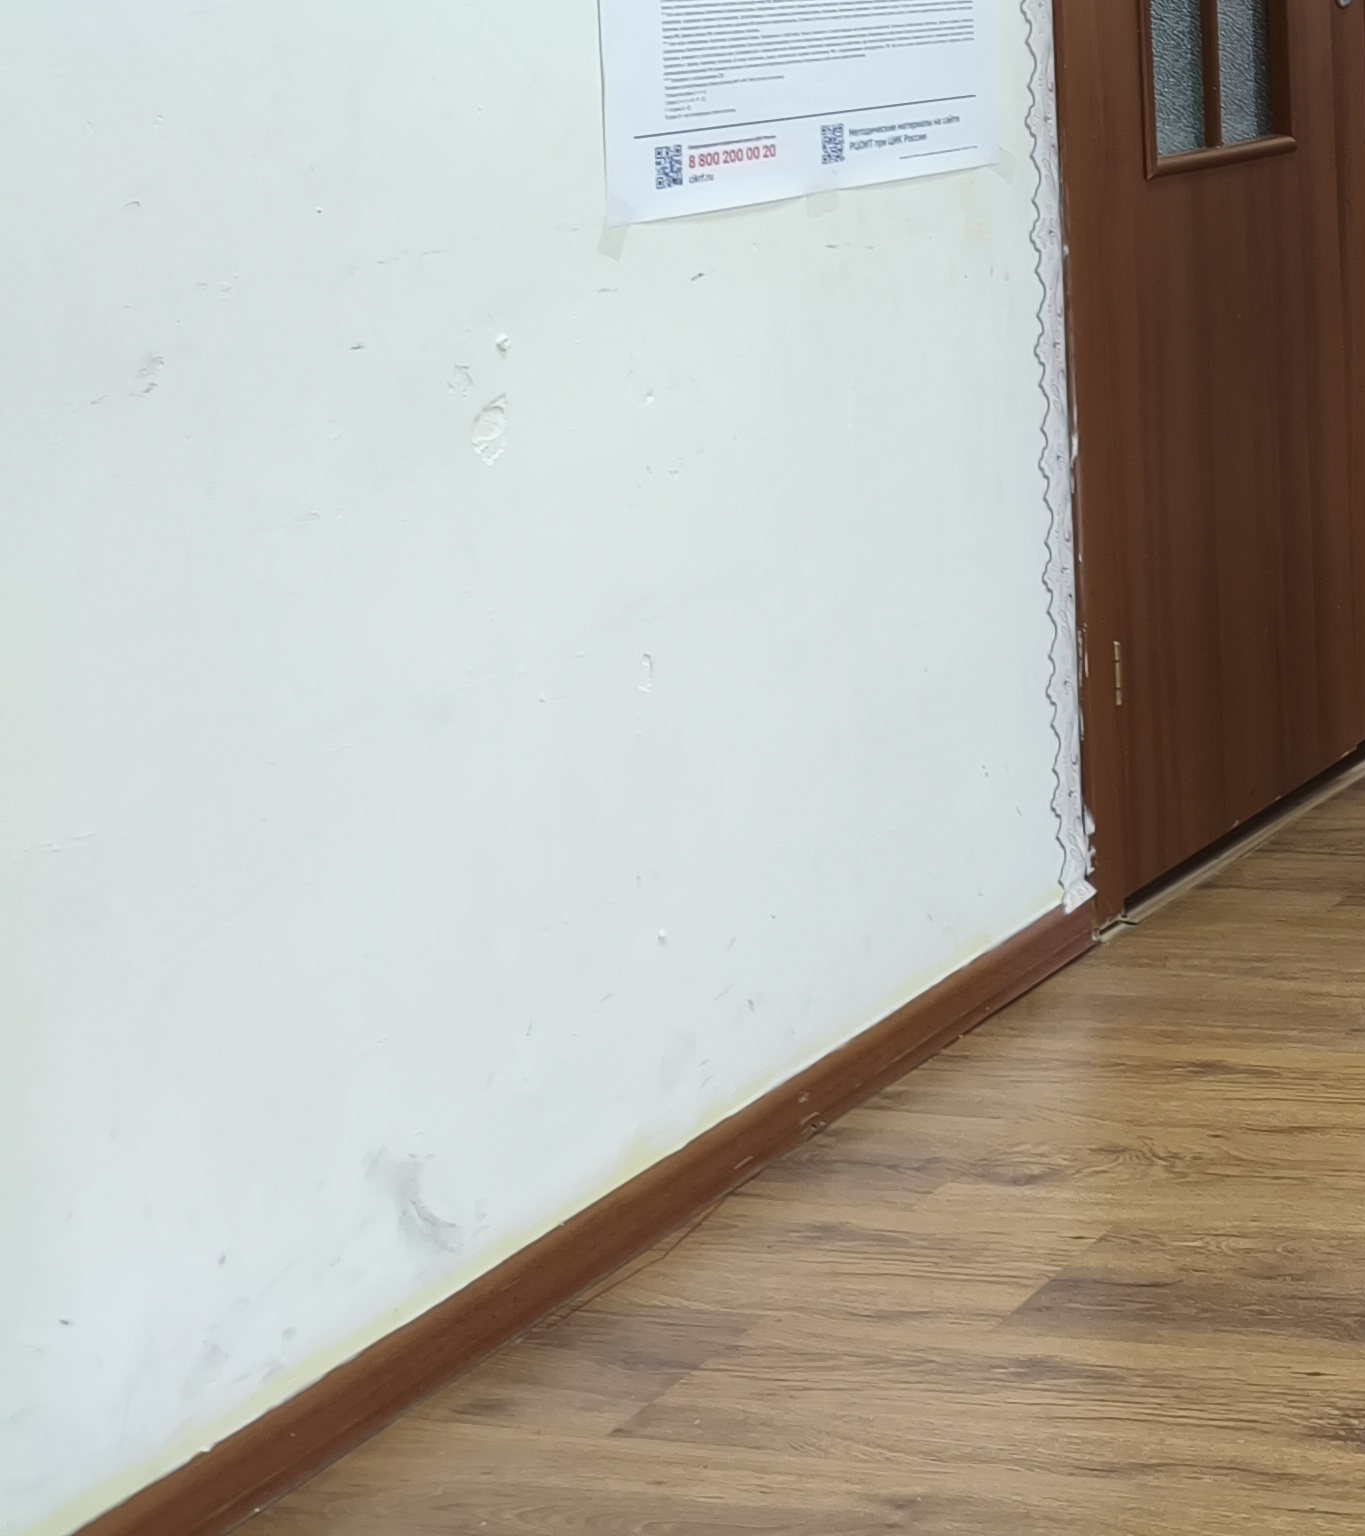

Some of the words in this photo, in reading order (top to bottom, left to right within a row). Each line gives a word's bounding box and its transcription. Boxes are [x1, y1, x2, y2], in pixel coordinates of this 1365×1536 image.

[689, 154, 696, 169] 8
[698, 151, 720, 167] 800
[722, 148, 744, 164] 200
[746, 146, 760, 160] 00
[762, 144, 776, 158] 20
